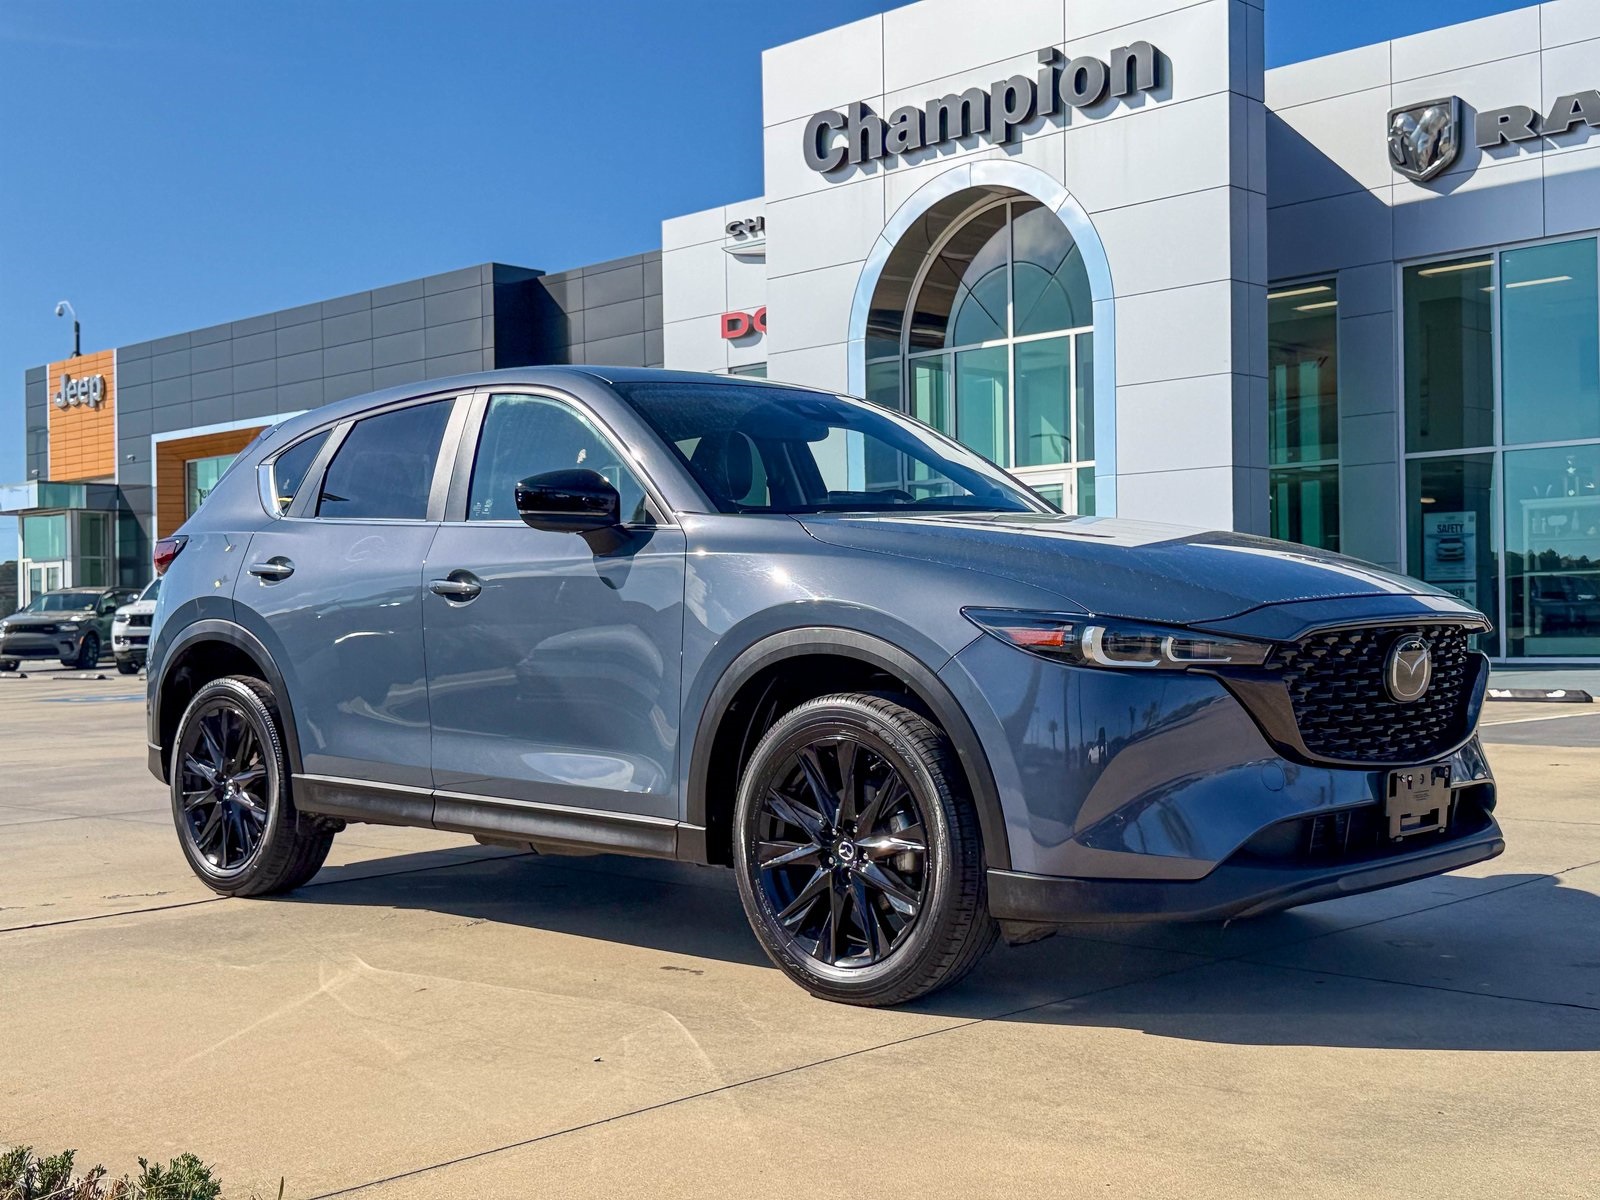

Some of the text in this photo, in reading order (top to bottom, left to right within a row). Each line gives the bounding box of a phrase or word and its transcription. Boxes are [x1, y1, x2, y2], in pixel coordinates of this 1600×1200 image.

[803, 40, 1158, 173] Champion
[54, 374, 104, 408] Jeep
[1436, 523, 1465, 534] SAFETY
